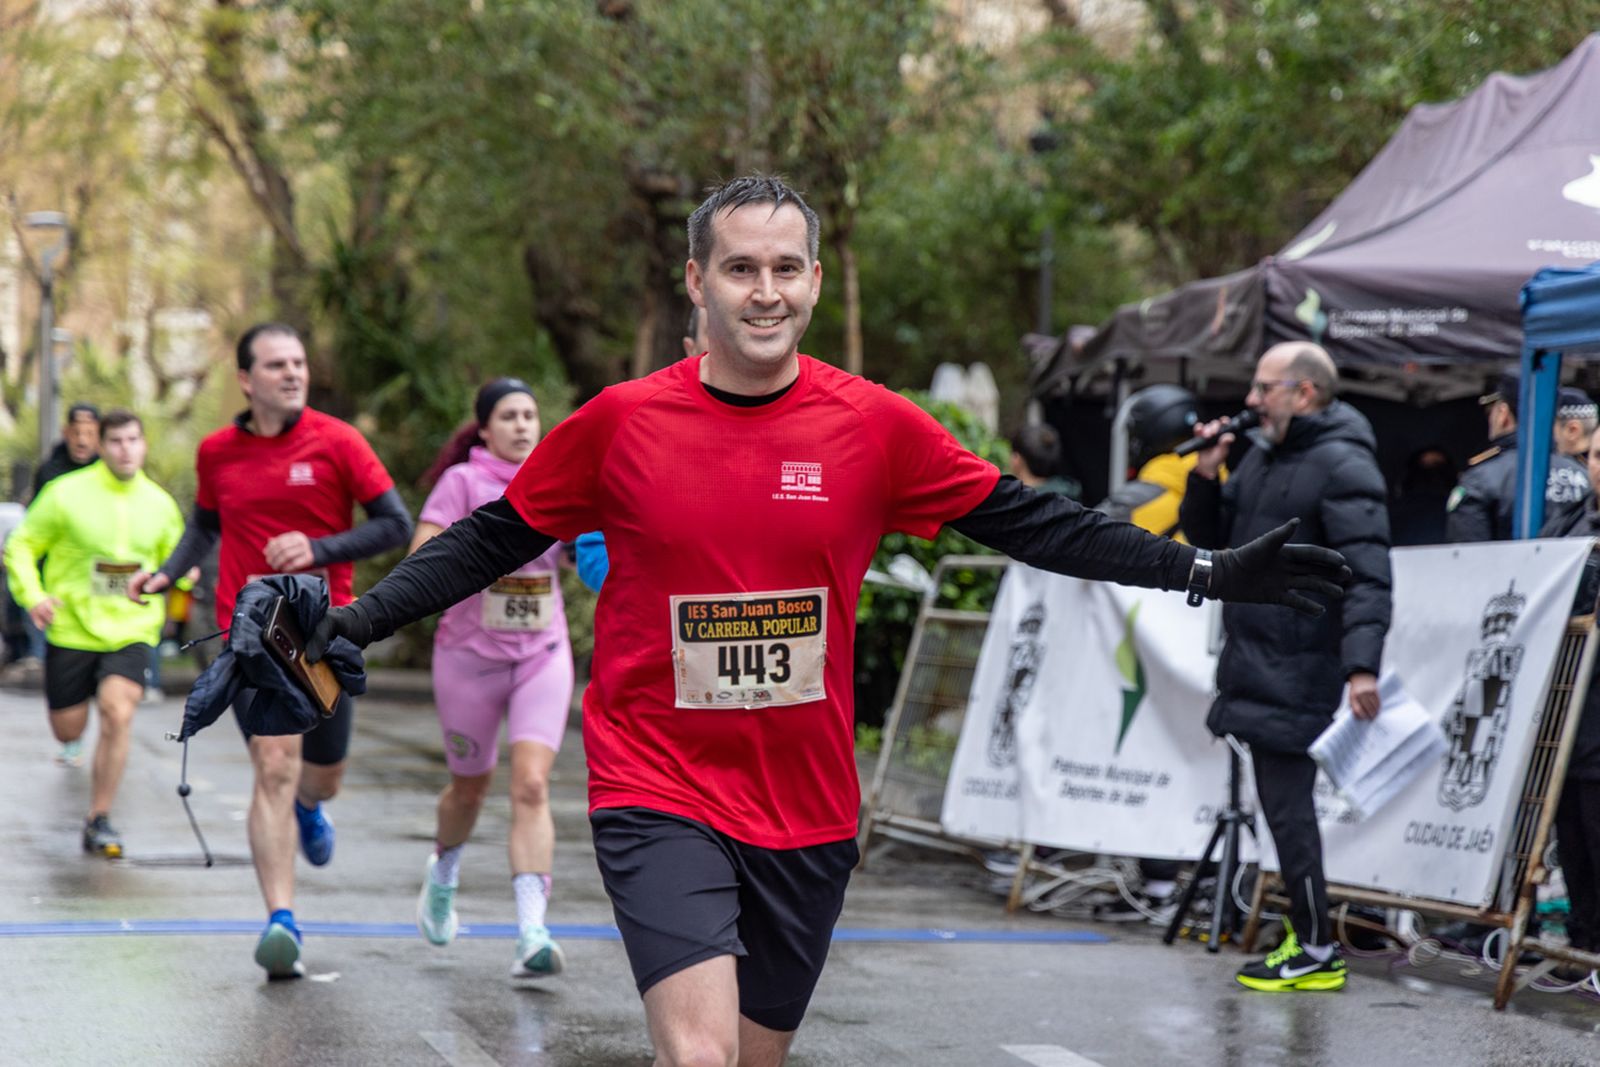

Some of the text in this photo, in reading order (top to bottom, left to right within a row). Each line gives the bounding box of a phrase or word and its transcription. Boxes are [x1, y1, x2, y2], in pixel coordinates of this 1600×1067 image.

[505, 599, 540, 618] 694
[687, 599, 814, 619] IES San Juan Bosco
[684, 615, 817, 639] V CARRERA POPULAR
[717, 643, 791, 686] 443
